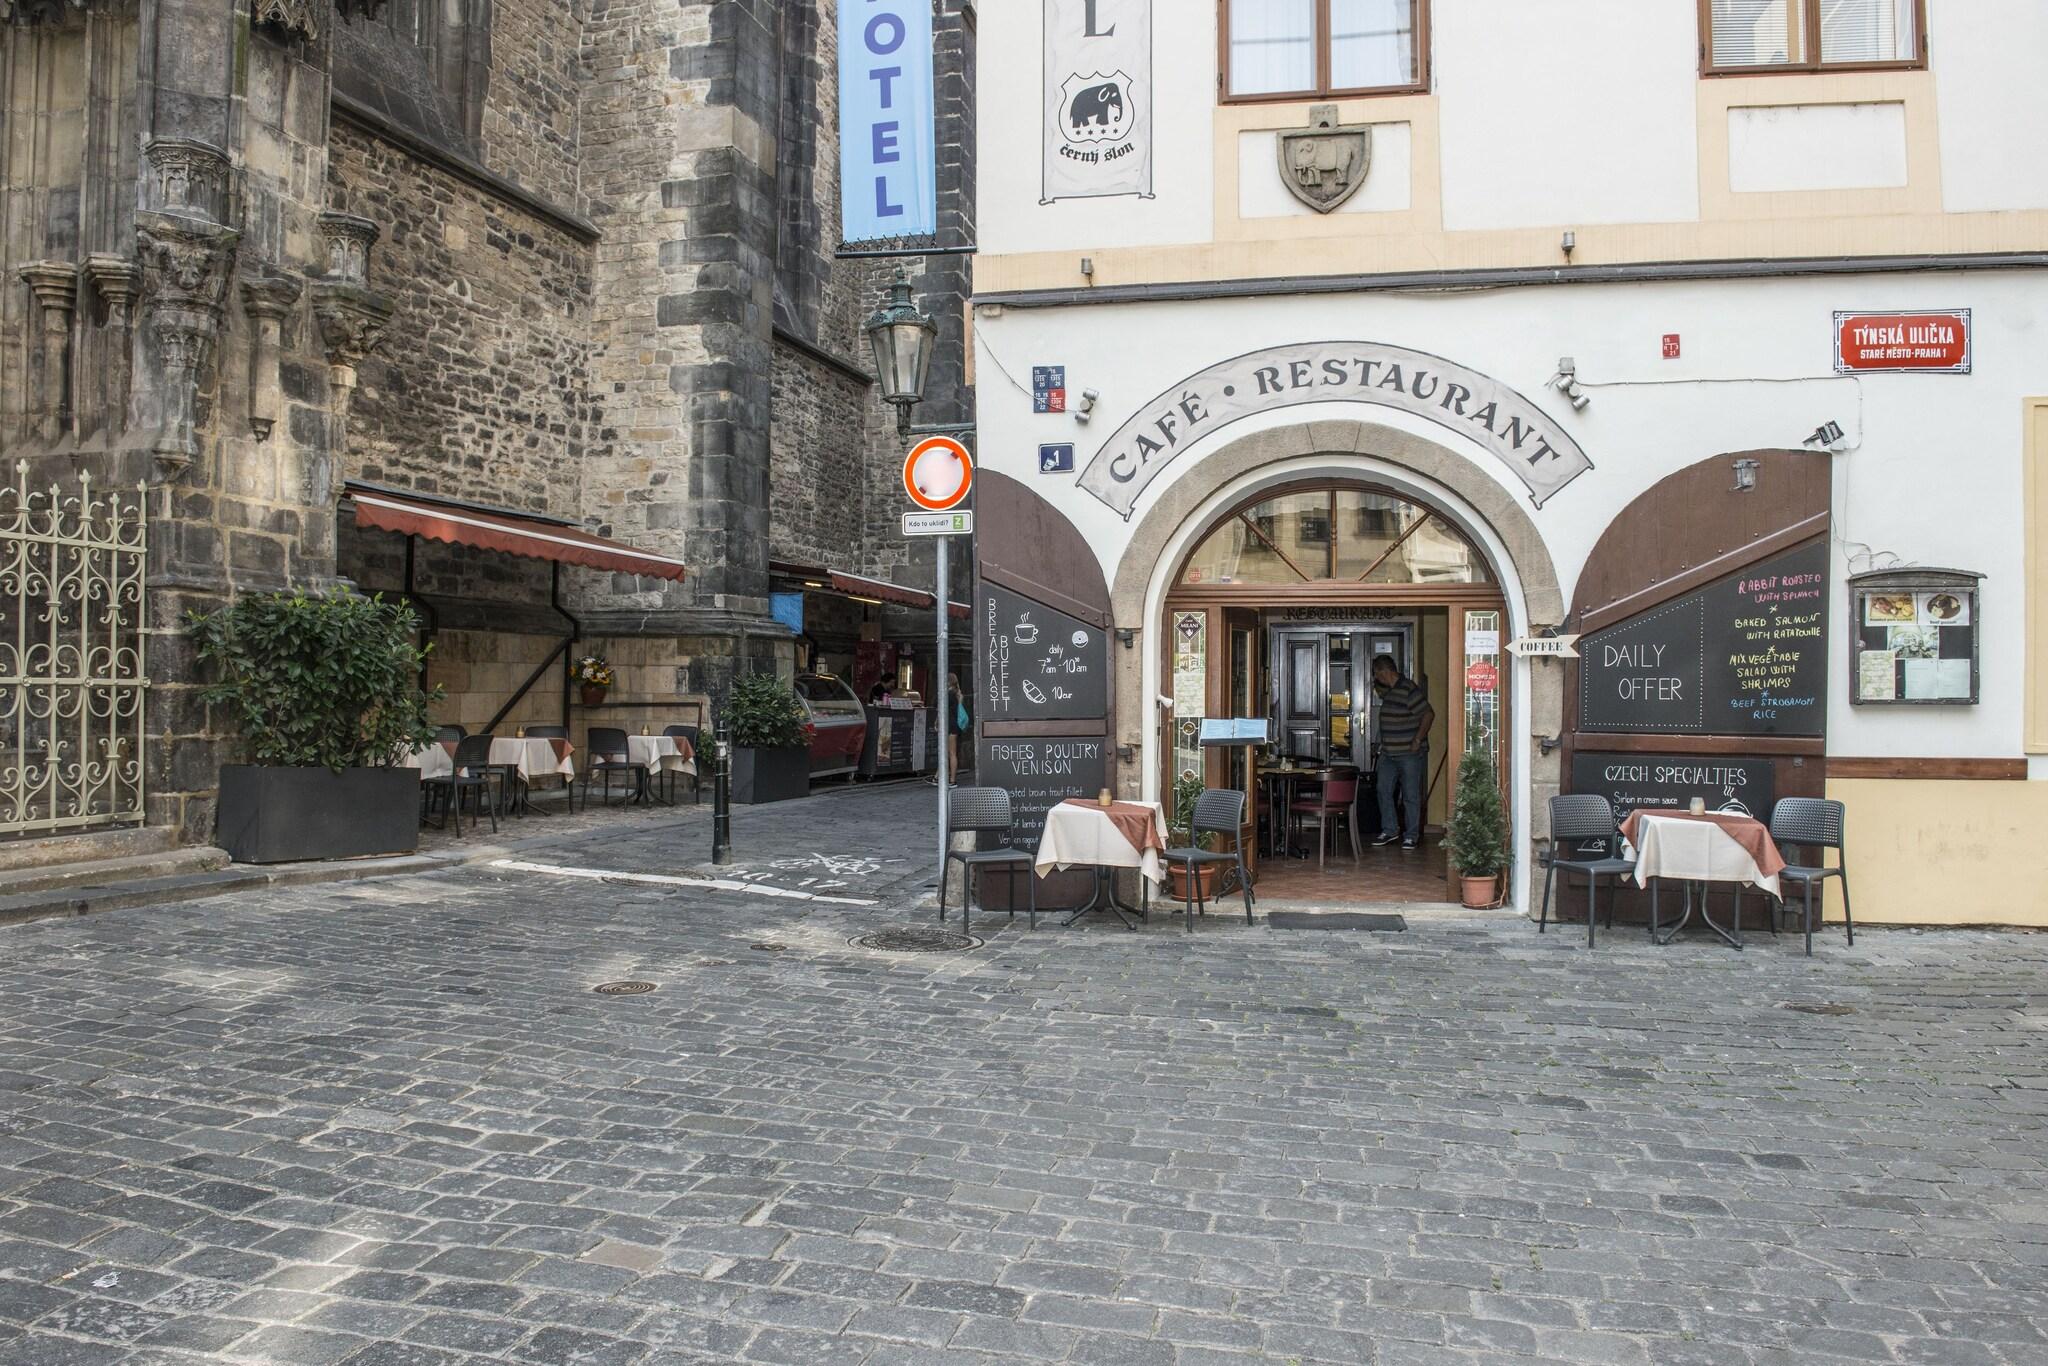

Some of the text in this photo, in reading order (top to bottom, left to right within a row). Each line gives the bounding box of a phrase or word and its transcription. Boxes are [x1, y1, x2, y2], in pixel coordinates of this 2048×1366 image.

[864, 0, 906, 217] OTEL
[1060, 142, 1135, 165] černý slon
[1853, 322, 1955, 346] TÝNSKÁ ULIČKA
[1860, 347, 1885, 359] STARÉ
[1109, 359, 1561, 483] CAFÉ RESTAURANT
[1053, 450, 1060, 466] 1
[1738, 577, 1778, 594] RABBIT
[1755, 592, 1779, 603] WITH
[1735, 612, 1821, 629] BAKED SALMON
[1746, 630, 1770, 640] WITH
[988, 598, 999, 712] BREAKFAST
[1520, 642, 1563, 652] COFFEE
[1604, 644, 1666, 668] DAILY
[1729, 653, 1747, 666] MIX
[1000, 635, 1010, 712] BUFFET
[1737, 665, 1796, 678] SALAD WITH
[1618, 678, 1683, 701] OFFER
[1741, 677, 1792, 690] SHRIMPS
[1731, 699, 1757, 708] BEEF
[1753, 709, 1777, 720] RICE
[992, 743, 1099, 761] FISHES POULTRY
[1012, 760, 1072, 776] VENISON
[1605, 766, 1748, 786] CZECH SPECIALTIES
